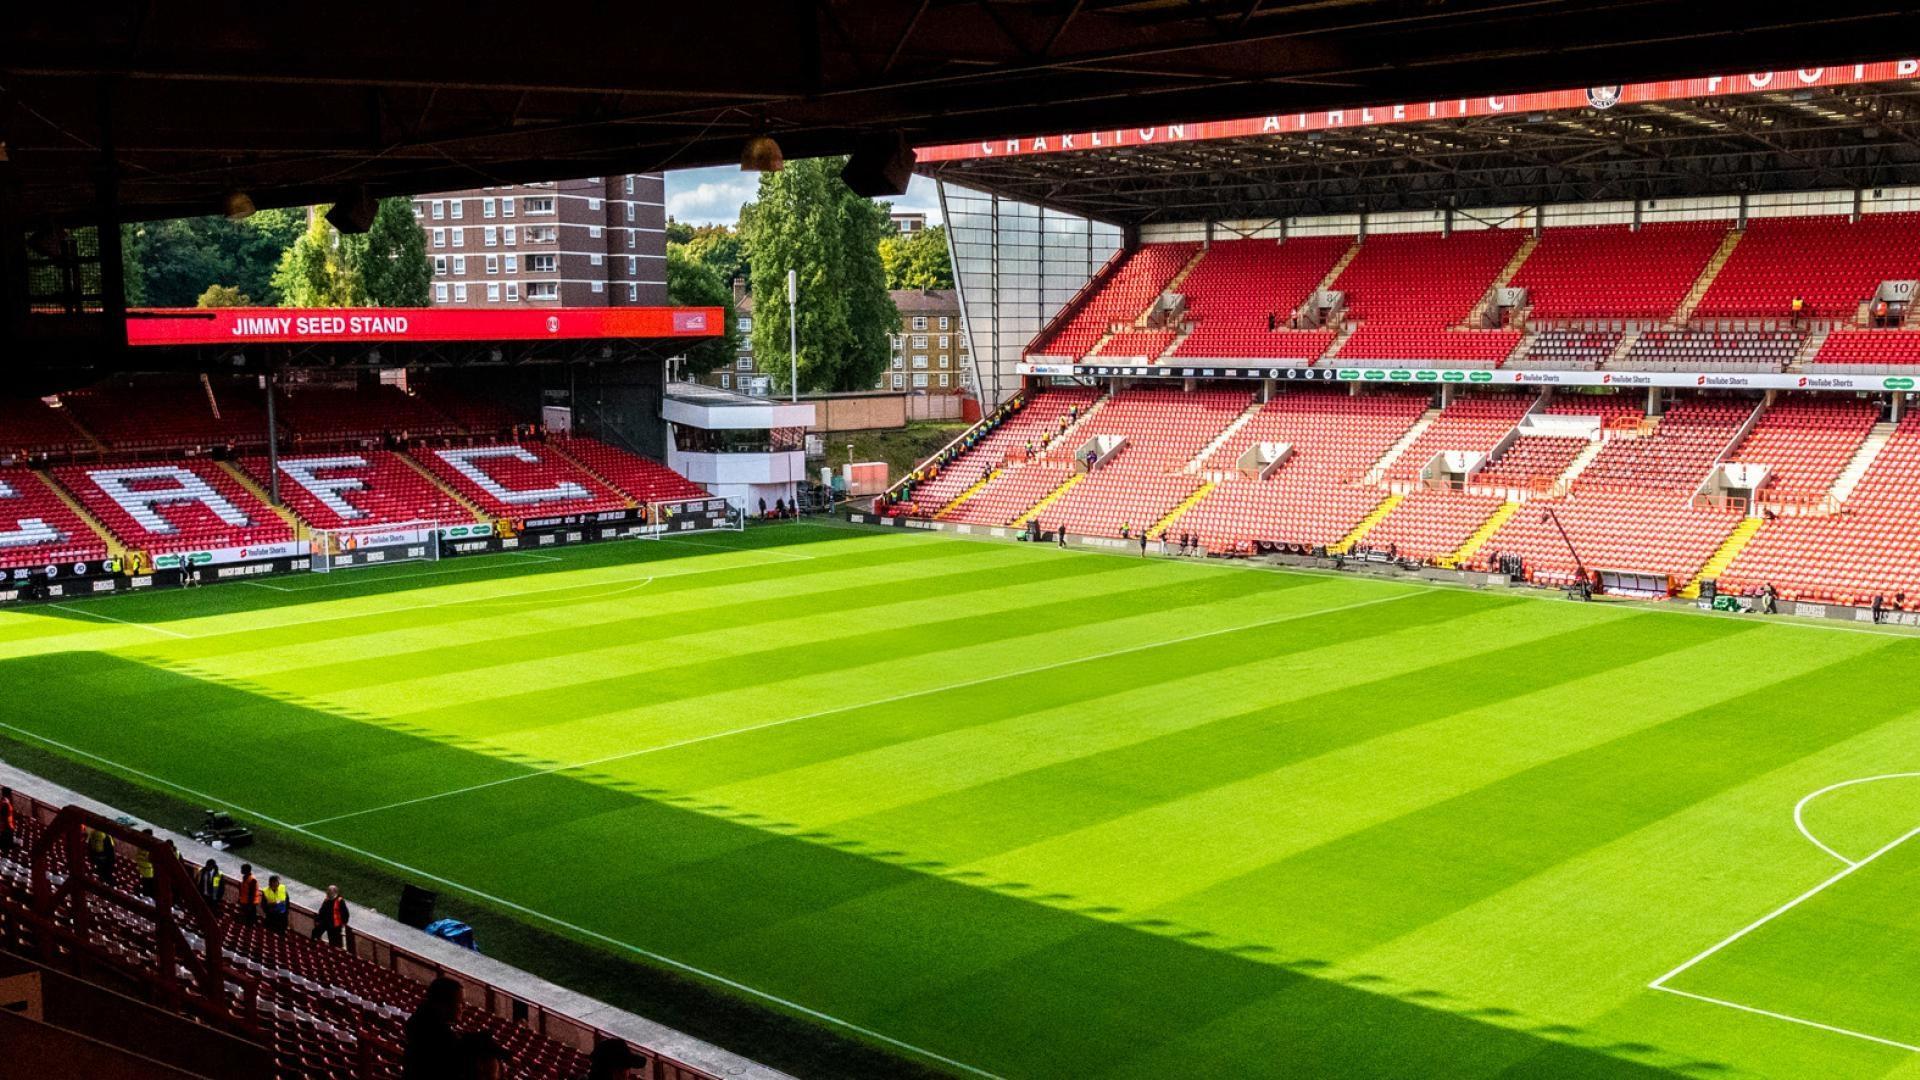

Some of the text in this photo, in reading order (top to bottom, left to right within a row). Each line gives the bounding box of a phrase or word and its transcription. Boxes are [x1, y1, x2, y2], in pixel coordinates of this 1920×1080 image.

[1894, 283, 1909, 294] 10
[1507, 290, 1515, 299] 9
[232, 316, 409, 335] JIMMY SEED STAND
[1633, 376, 1651, 384] Shorts
[1706, 377, 1748, 386] YouTube Shorts
[1808, 379, 1853, 388] YouTube Shorts
[248, 546, 287, 557] YouTube Shorts
